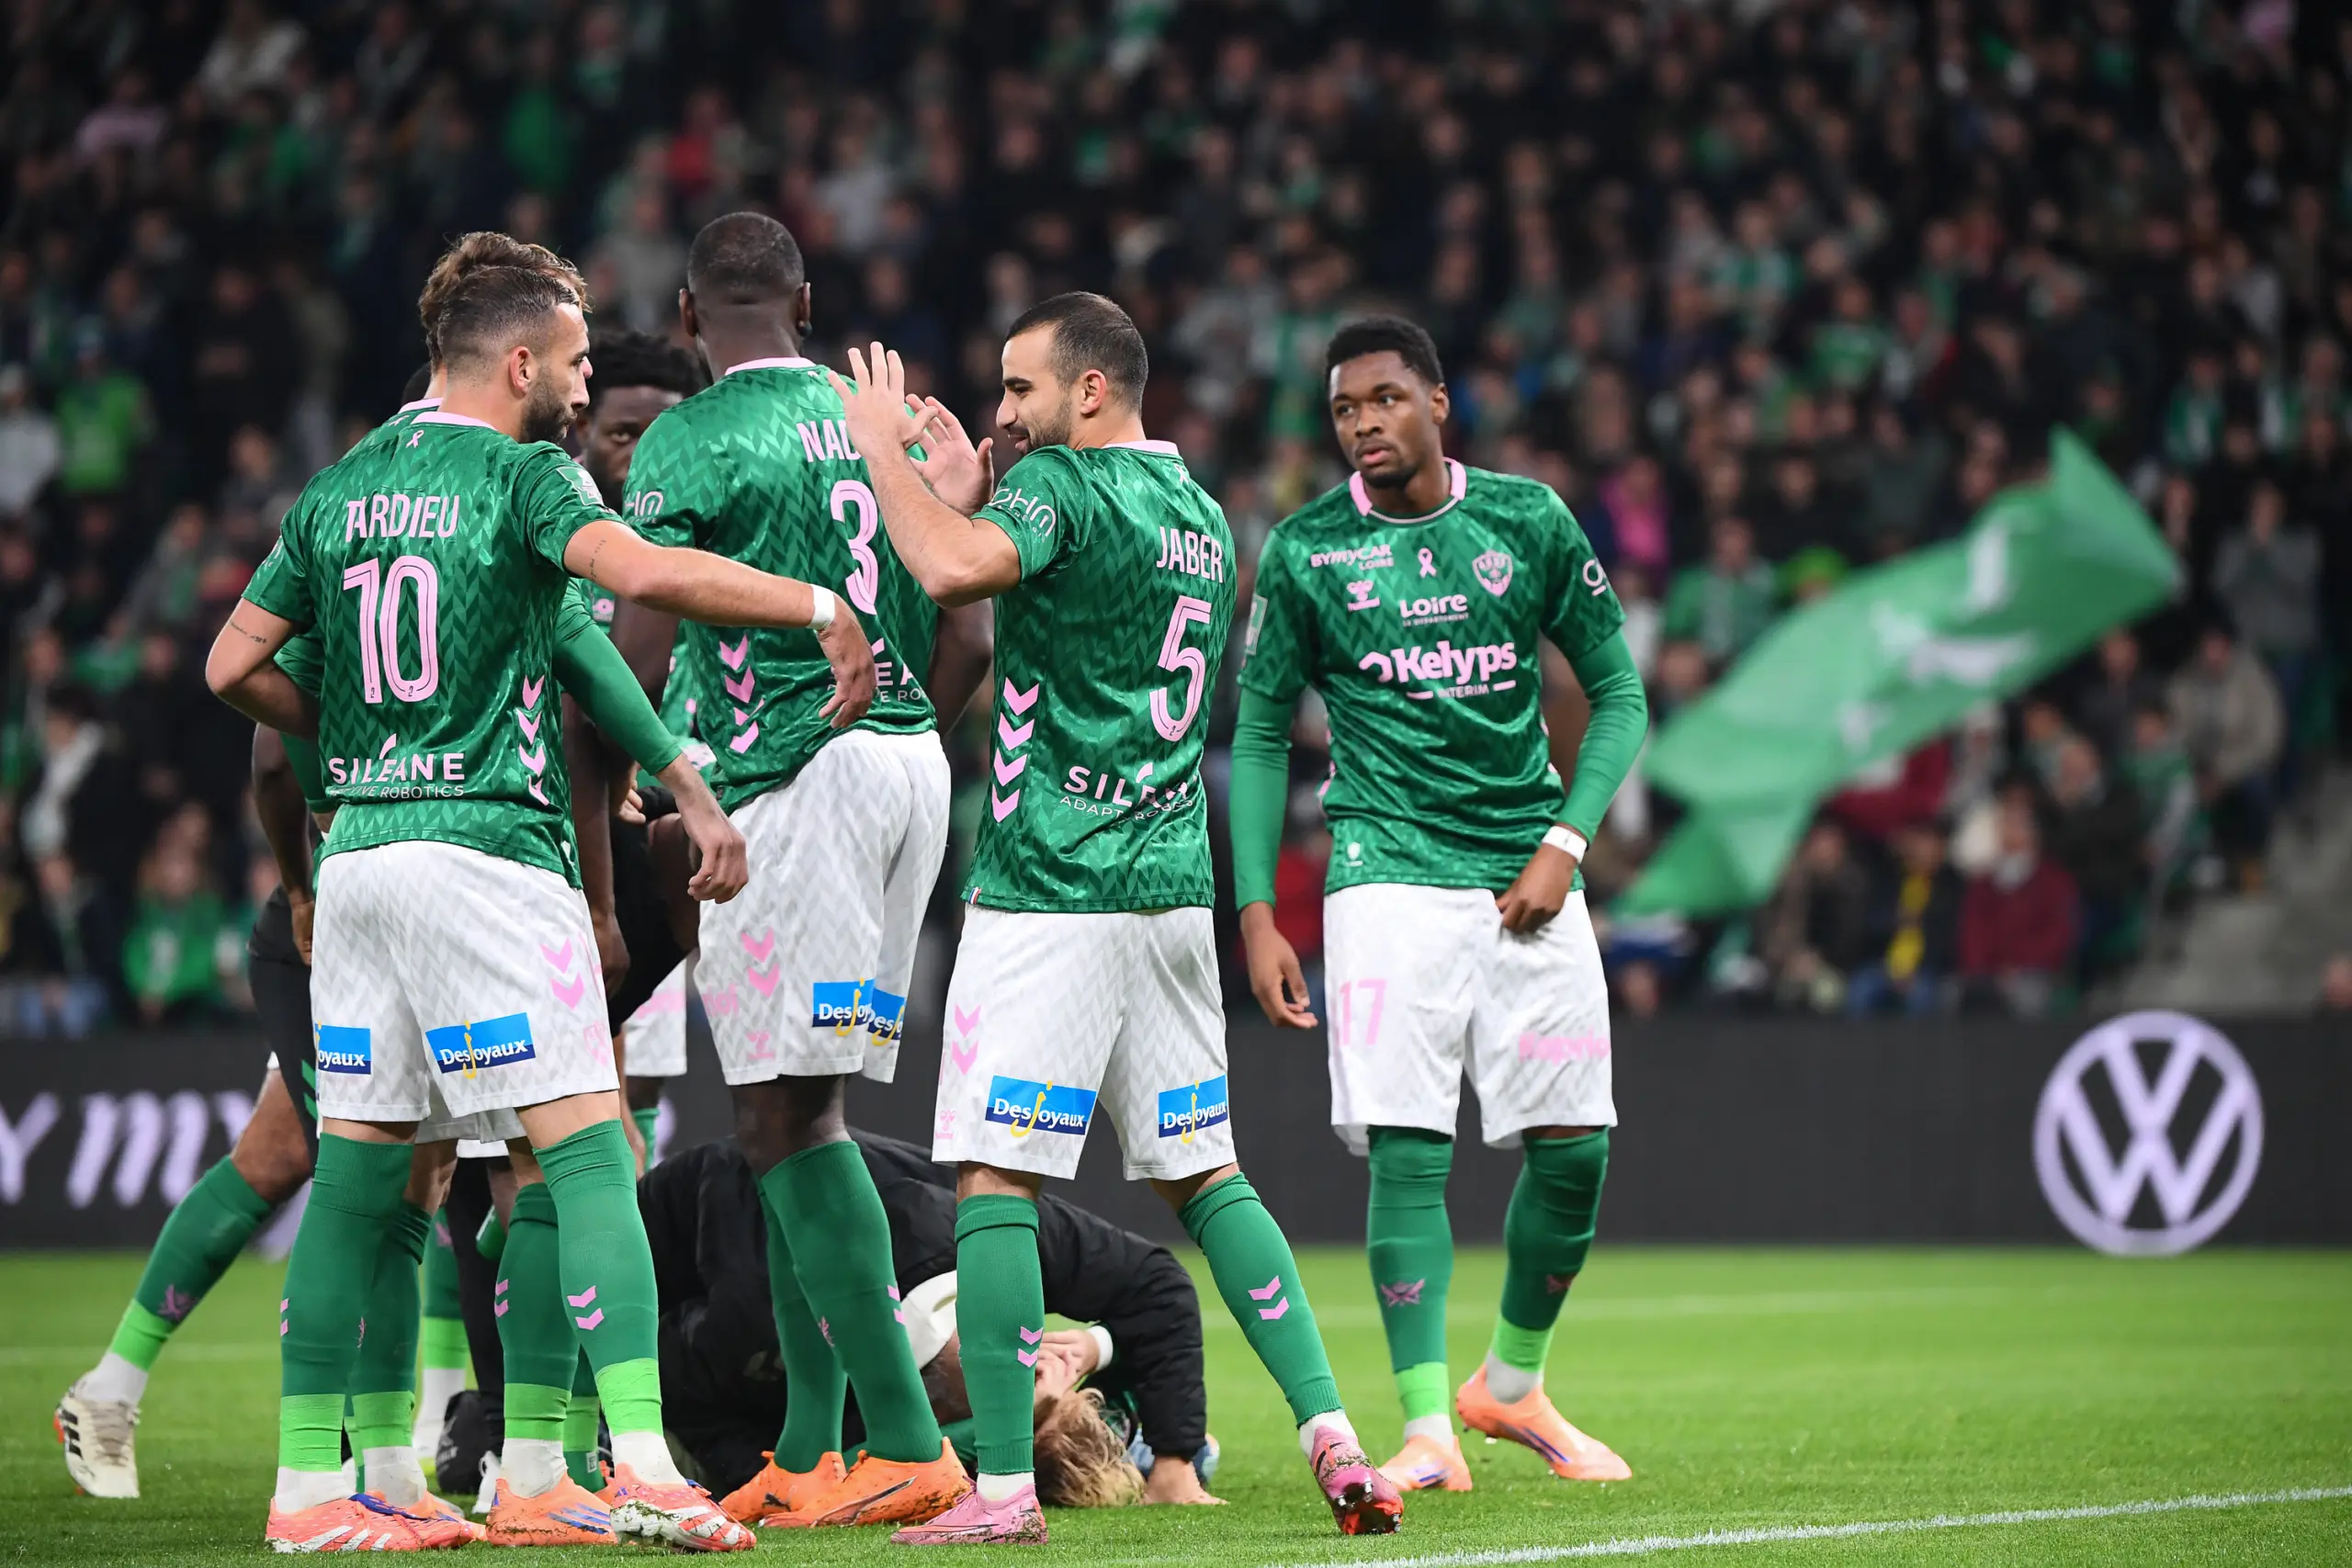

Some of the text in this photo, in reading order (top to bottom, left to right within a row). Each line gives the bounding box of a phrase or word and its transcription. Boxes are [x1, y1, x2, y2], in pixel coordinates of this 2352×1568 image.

[796, 419, 862, 463] NAD
[345, 493, 460, 543] TARDIEU
[830, 479, 879, 615] 3
[1156, 525, 1224, 583] JABER
[343, 555, 439, 704] 10
[1148, 595, 1213, 743] 5
[1390, 640, 1518, 684] Kelyps
[379, 784, 465, 799] ROBOTICS
[1060, 795, 1125, 819] ADAPT
[1339, 978, 1386, 1046] 17
[2032, 1009, 2265, 1258] VW
